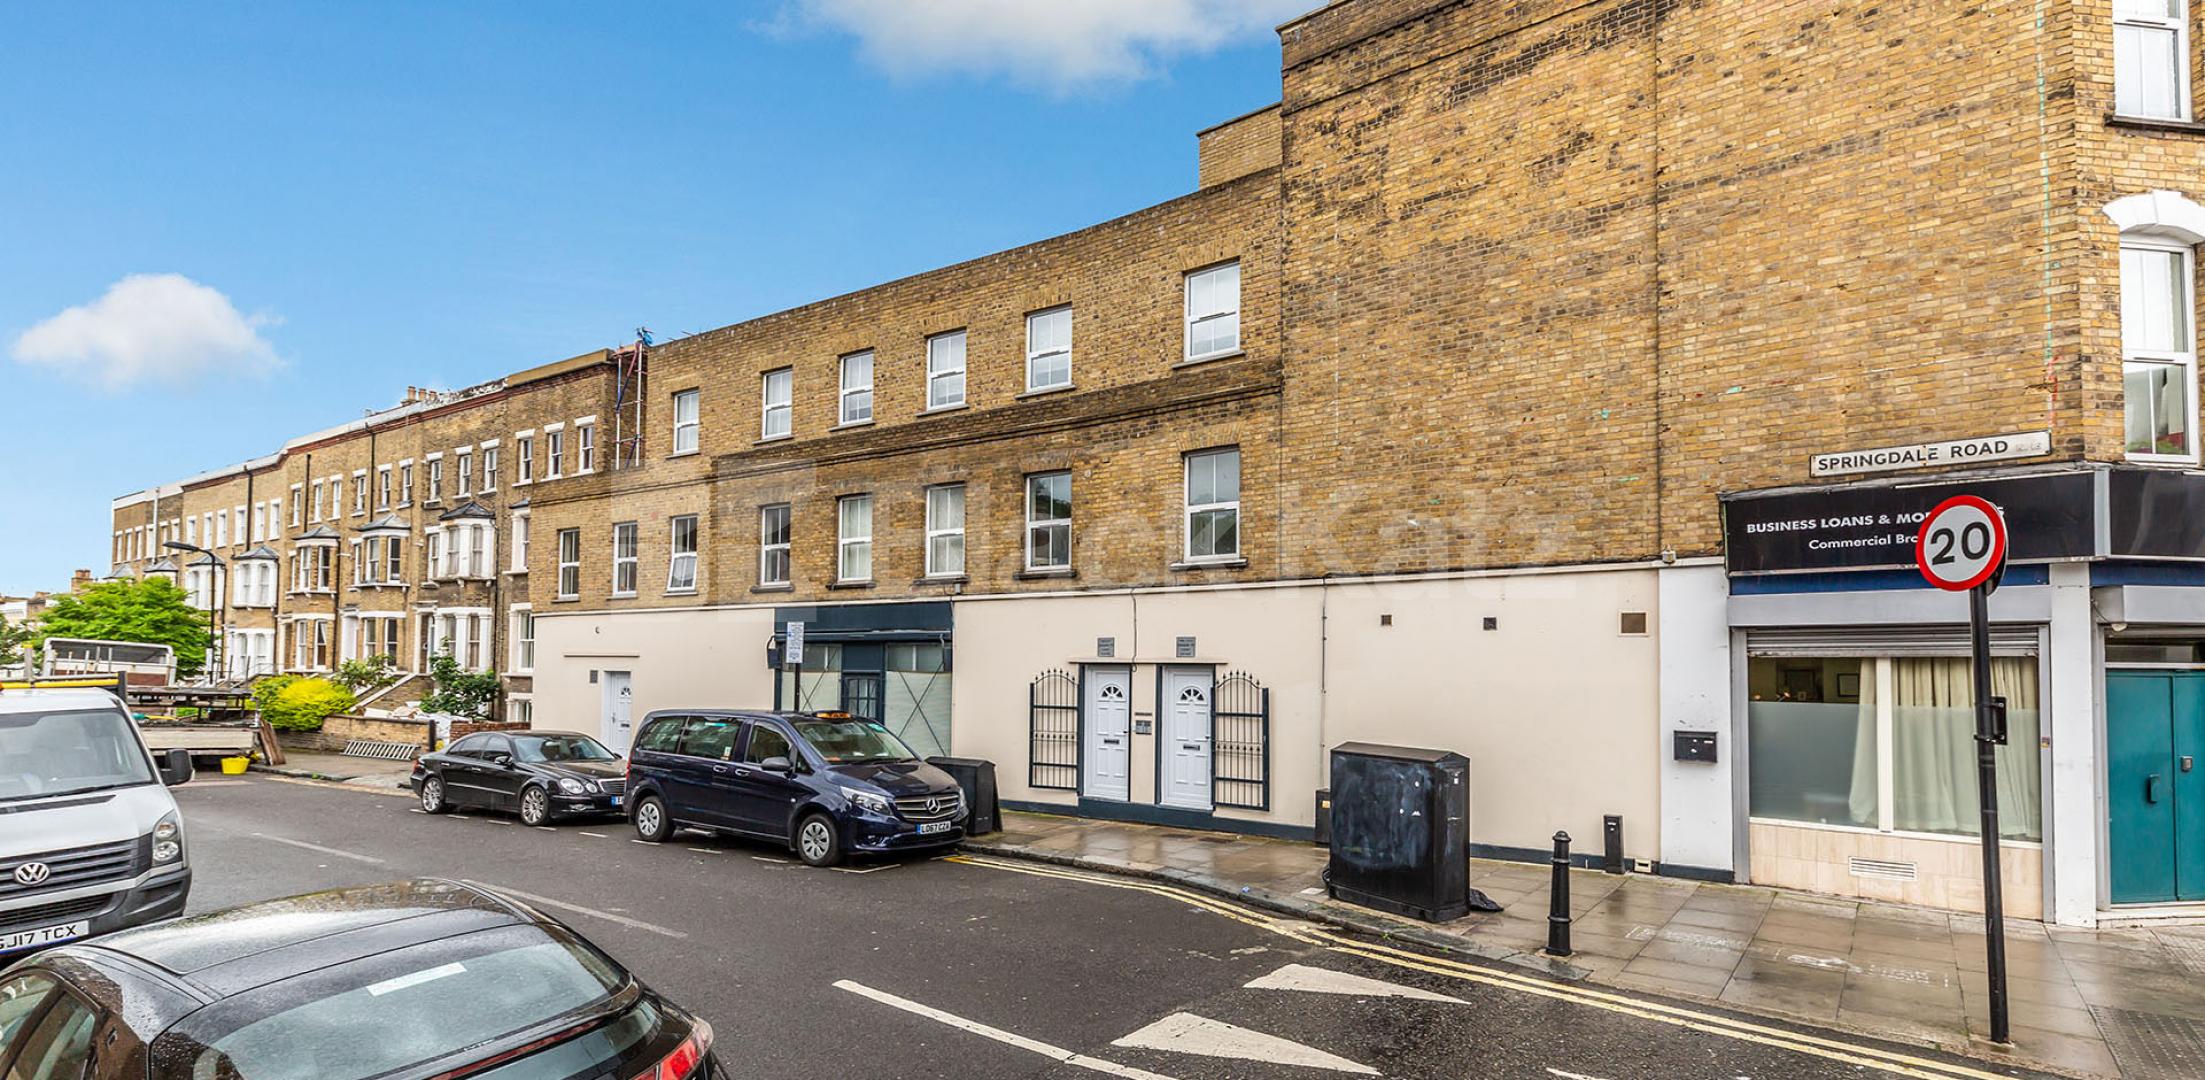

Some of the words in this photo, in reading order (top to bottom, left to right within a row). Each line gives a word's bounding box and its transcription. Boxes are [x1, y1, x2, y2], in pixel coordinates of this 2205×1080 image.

[1818, 447, 1938, 471] SPRINGDALE
[1950, 440, 2009, 459] ROAD
[1746, 519, 1817, 534] BUSINESS
[1820, 514, 1874, 529] LOANS
[1878, 514, 1892, 525] &
[1808, 534, 1892, 550] Commercial
[1930, 521, 1990, 565] 20
[42, 924, 77, 941] TCX
